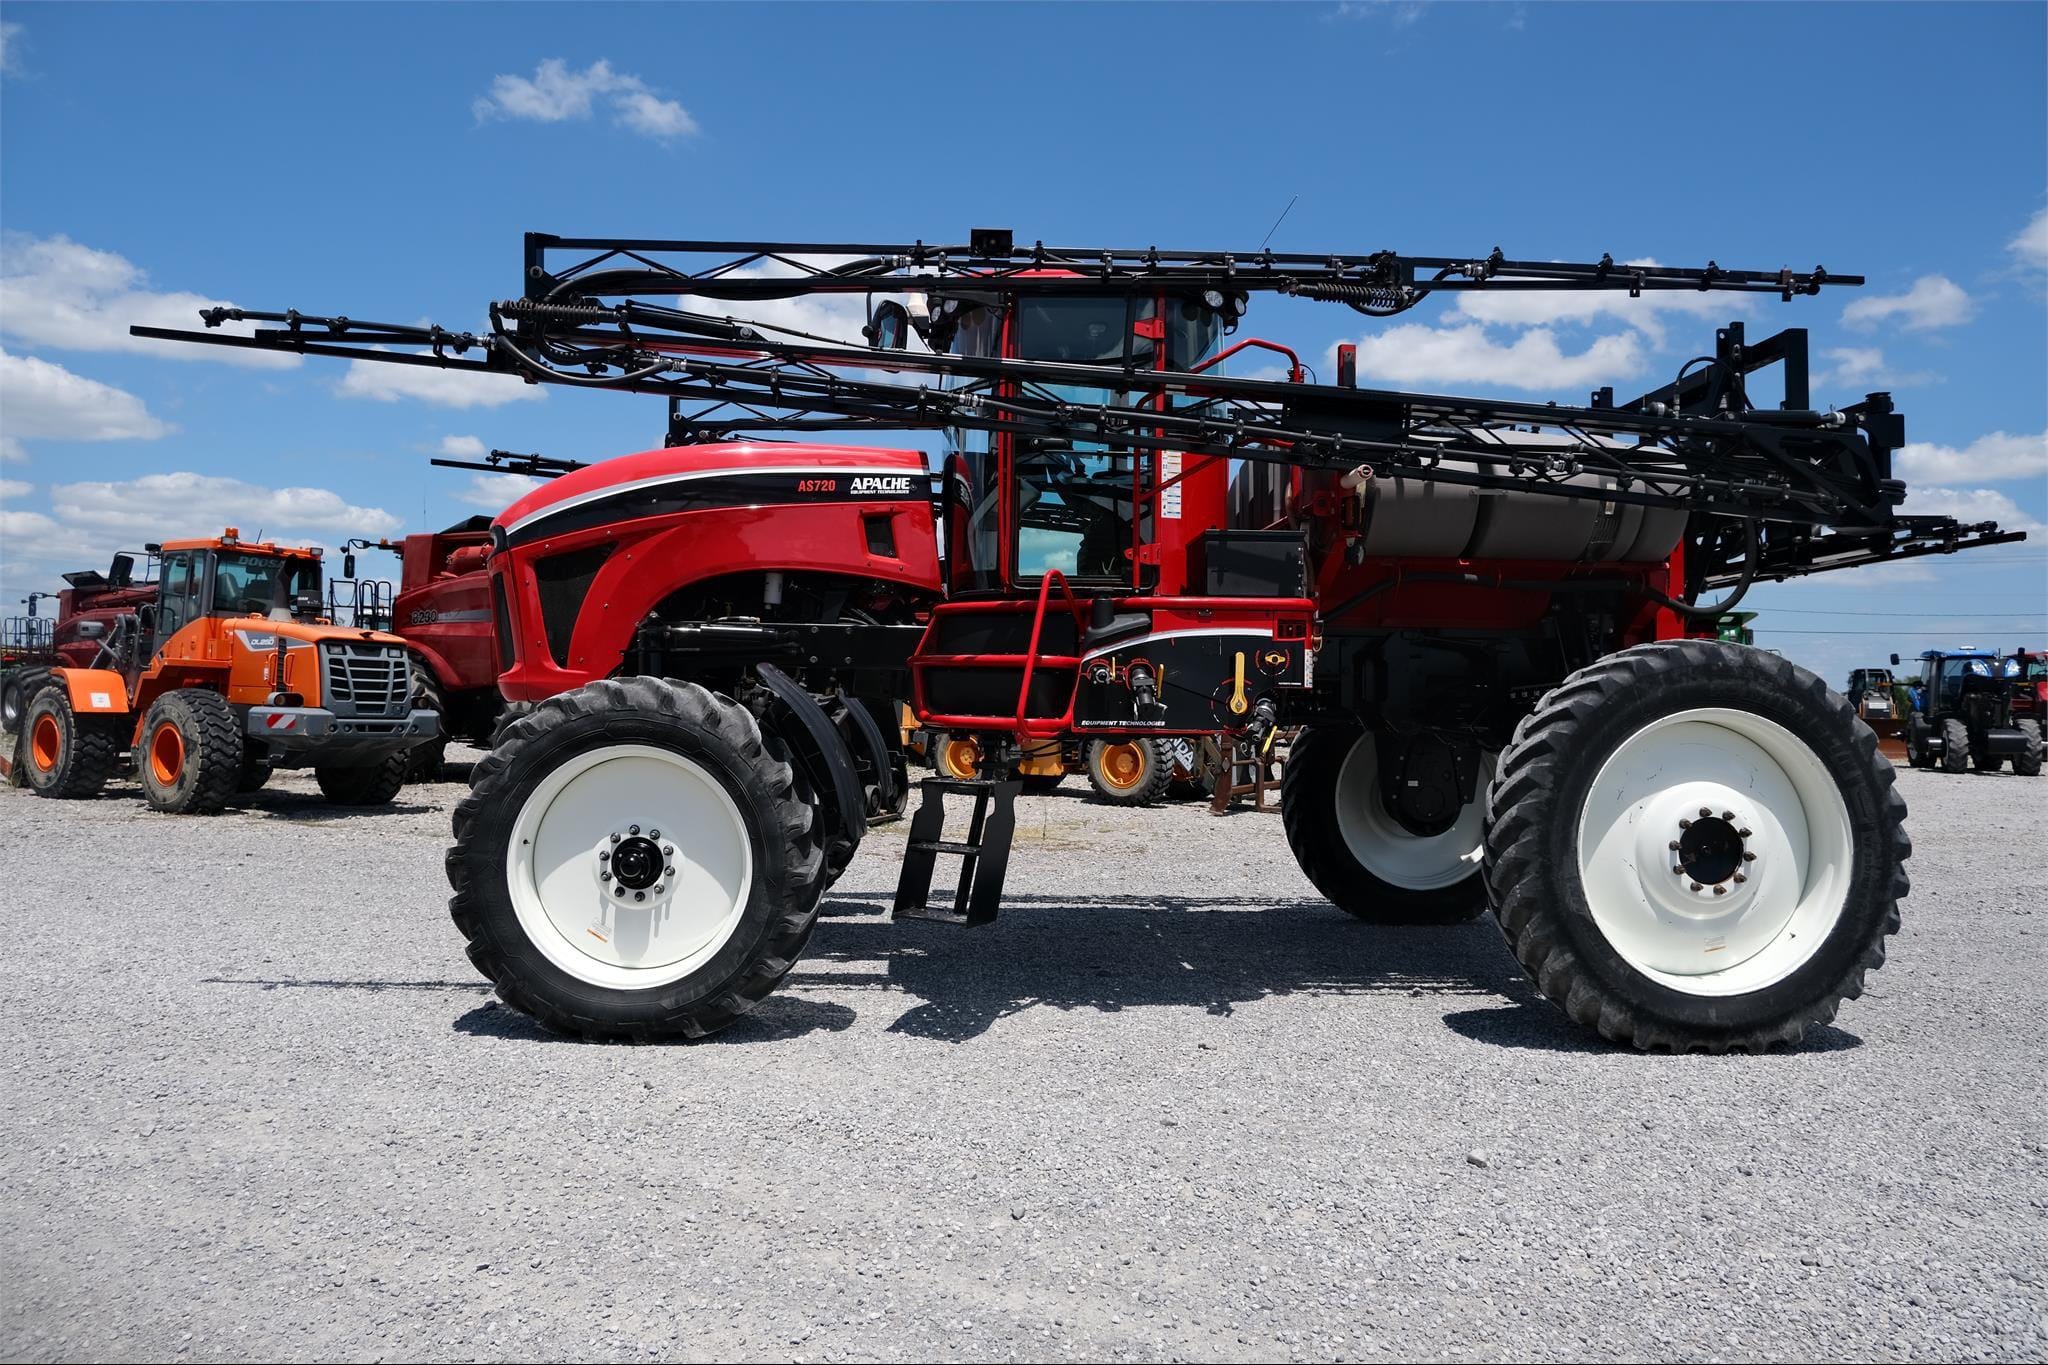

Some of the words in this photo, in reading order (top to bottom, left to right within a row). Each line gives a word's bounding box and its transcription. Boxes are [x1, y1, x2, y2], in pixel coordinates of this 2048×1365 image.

[798, 480, 836, 492] AS720
[850, 477, 911, 490] APACHE
[238, 556, 287, 568] DOOSA
